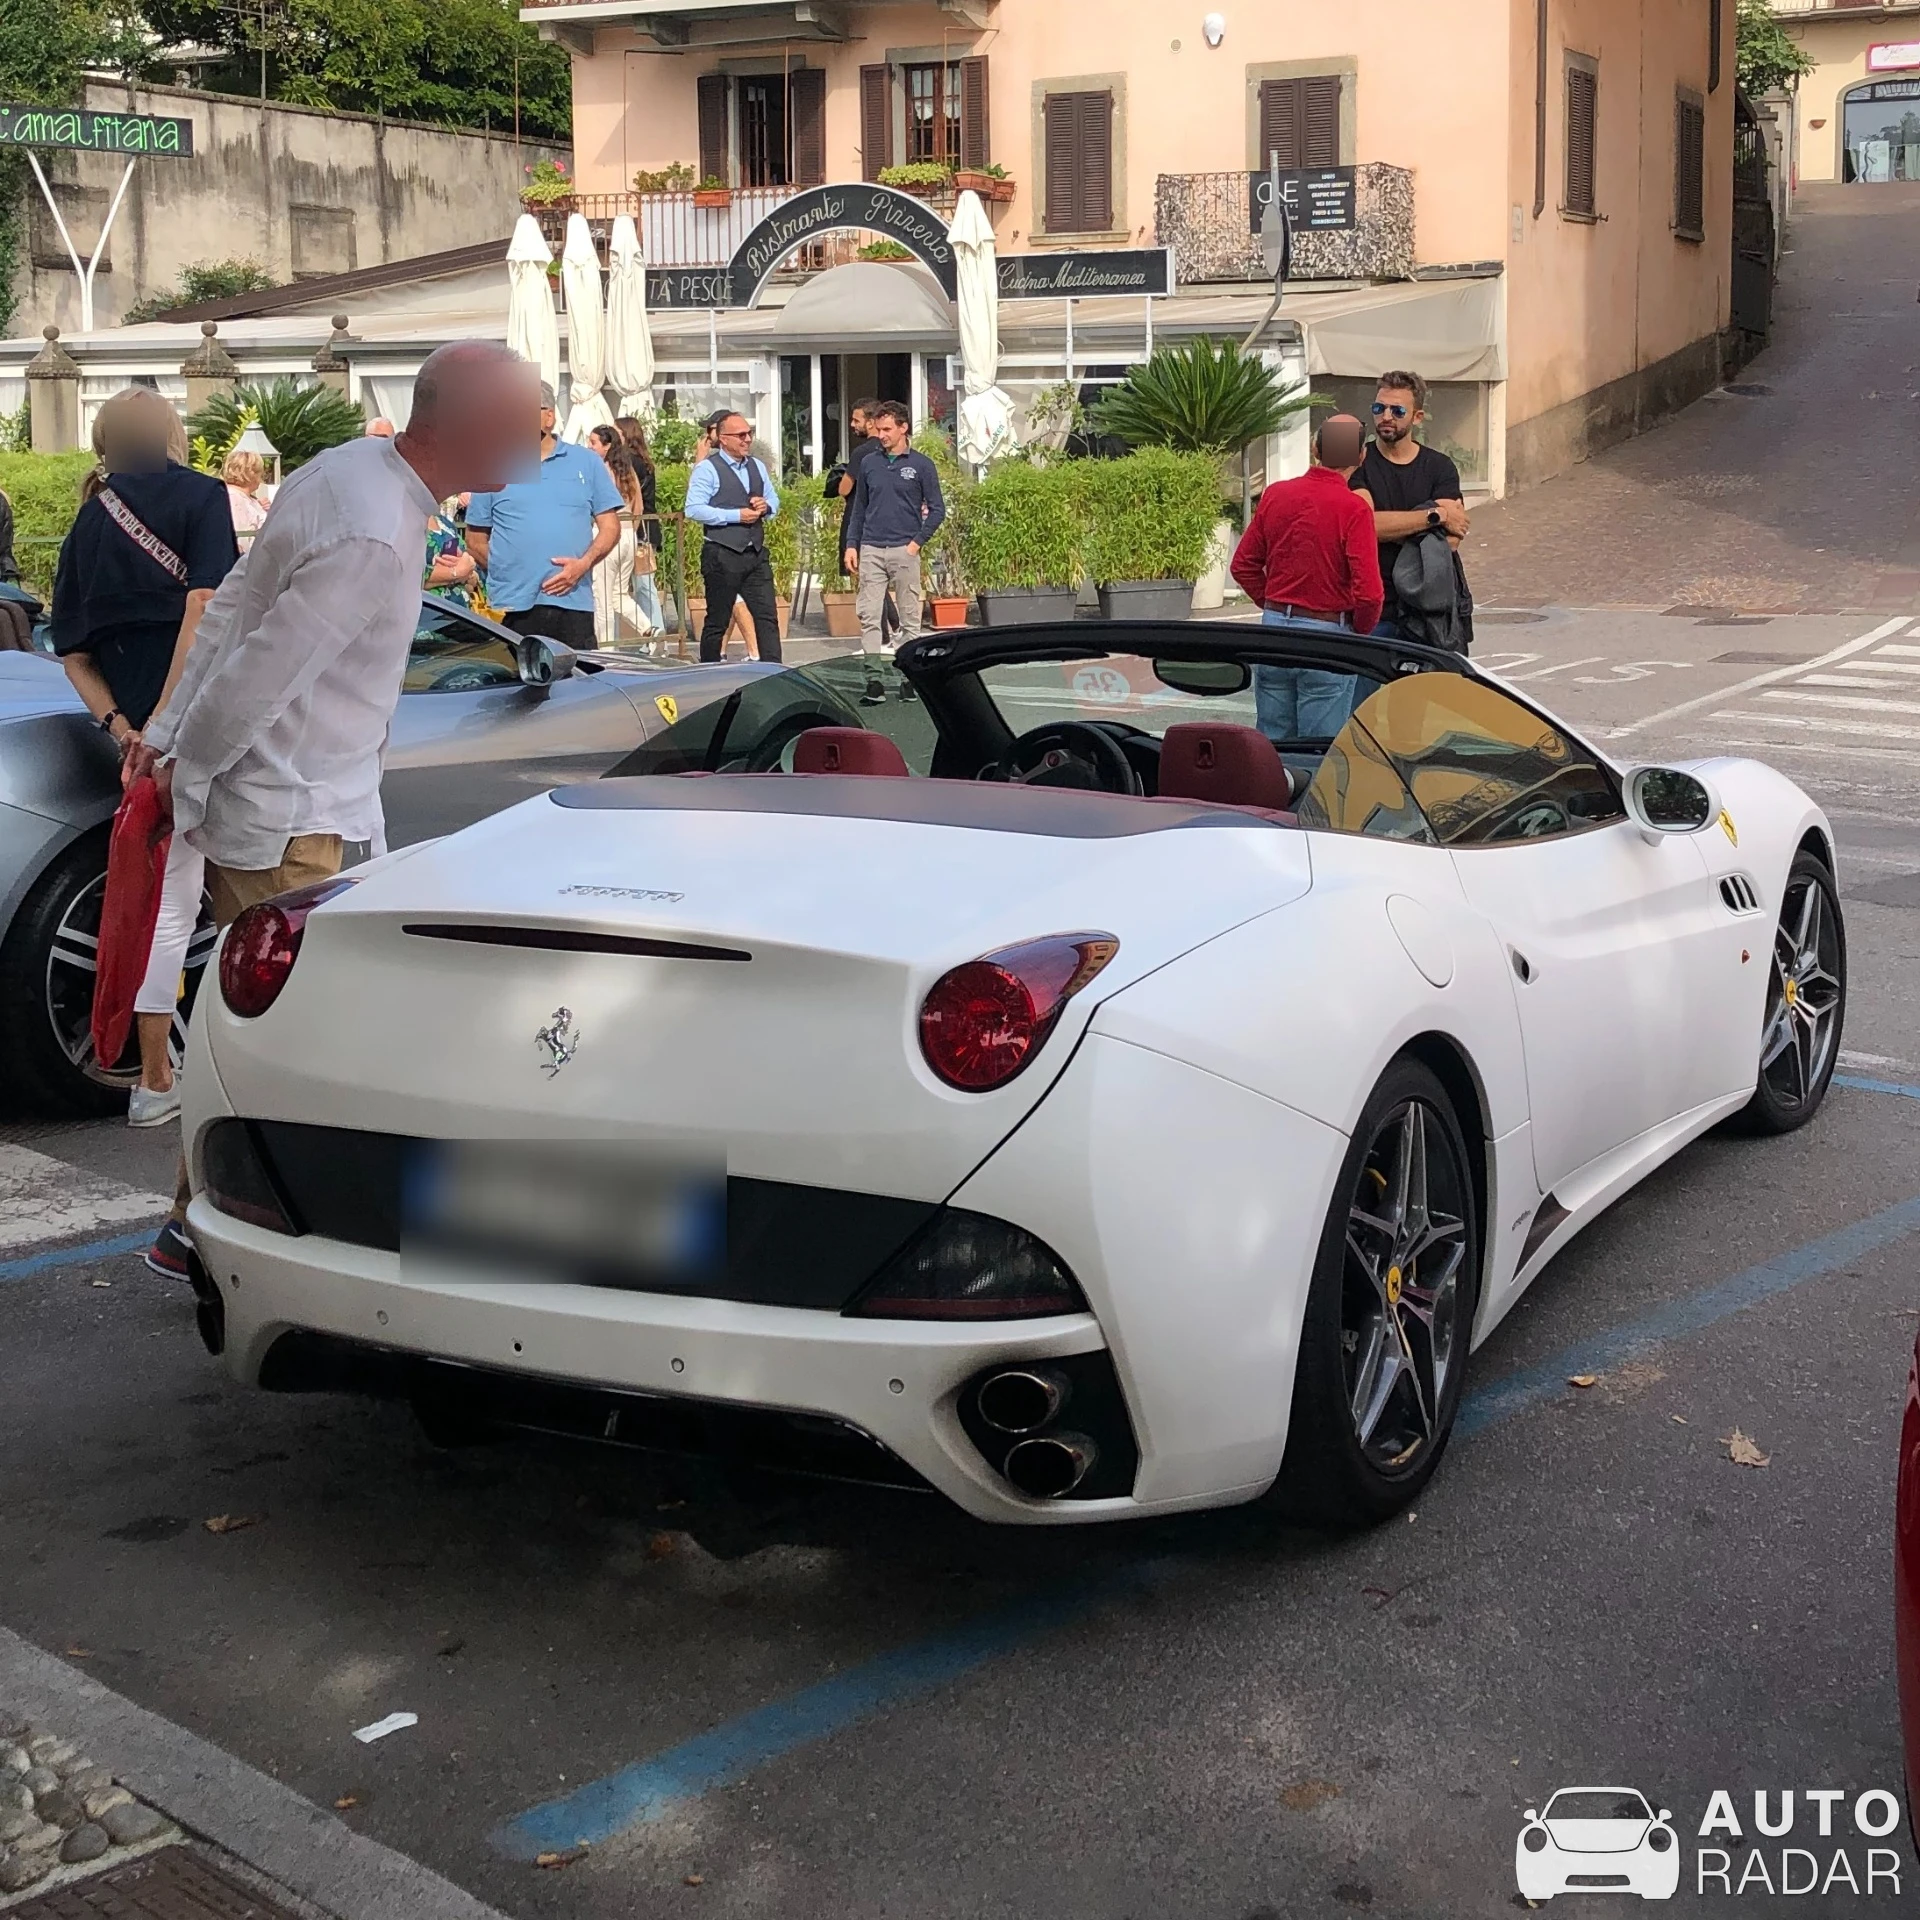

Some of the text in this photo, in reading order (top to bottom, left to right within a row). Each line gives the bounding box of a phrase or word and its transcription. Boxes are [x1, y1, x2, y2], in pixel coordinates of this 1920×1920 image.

[14, 112, 179, 150] amalfitana
[864, 191, 950, 265] Pizzeria
[680, 275, 735, 302] PESCE
[997, 260, 1147, 291] Cucina Mediterranea
